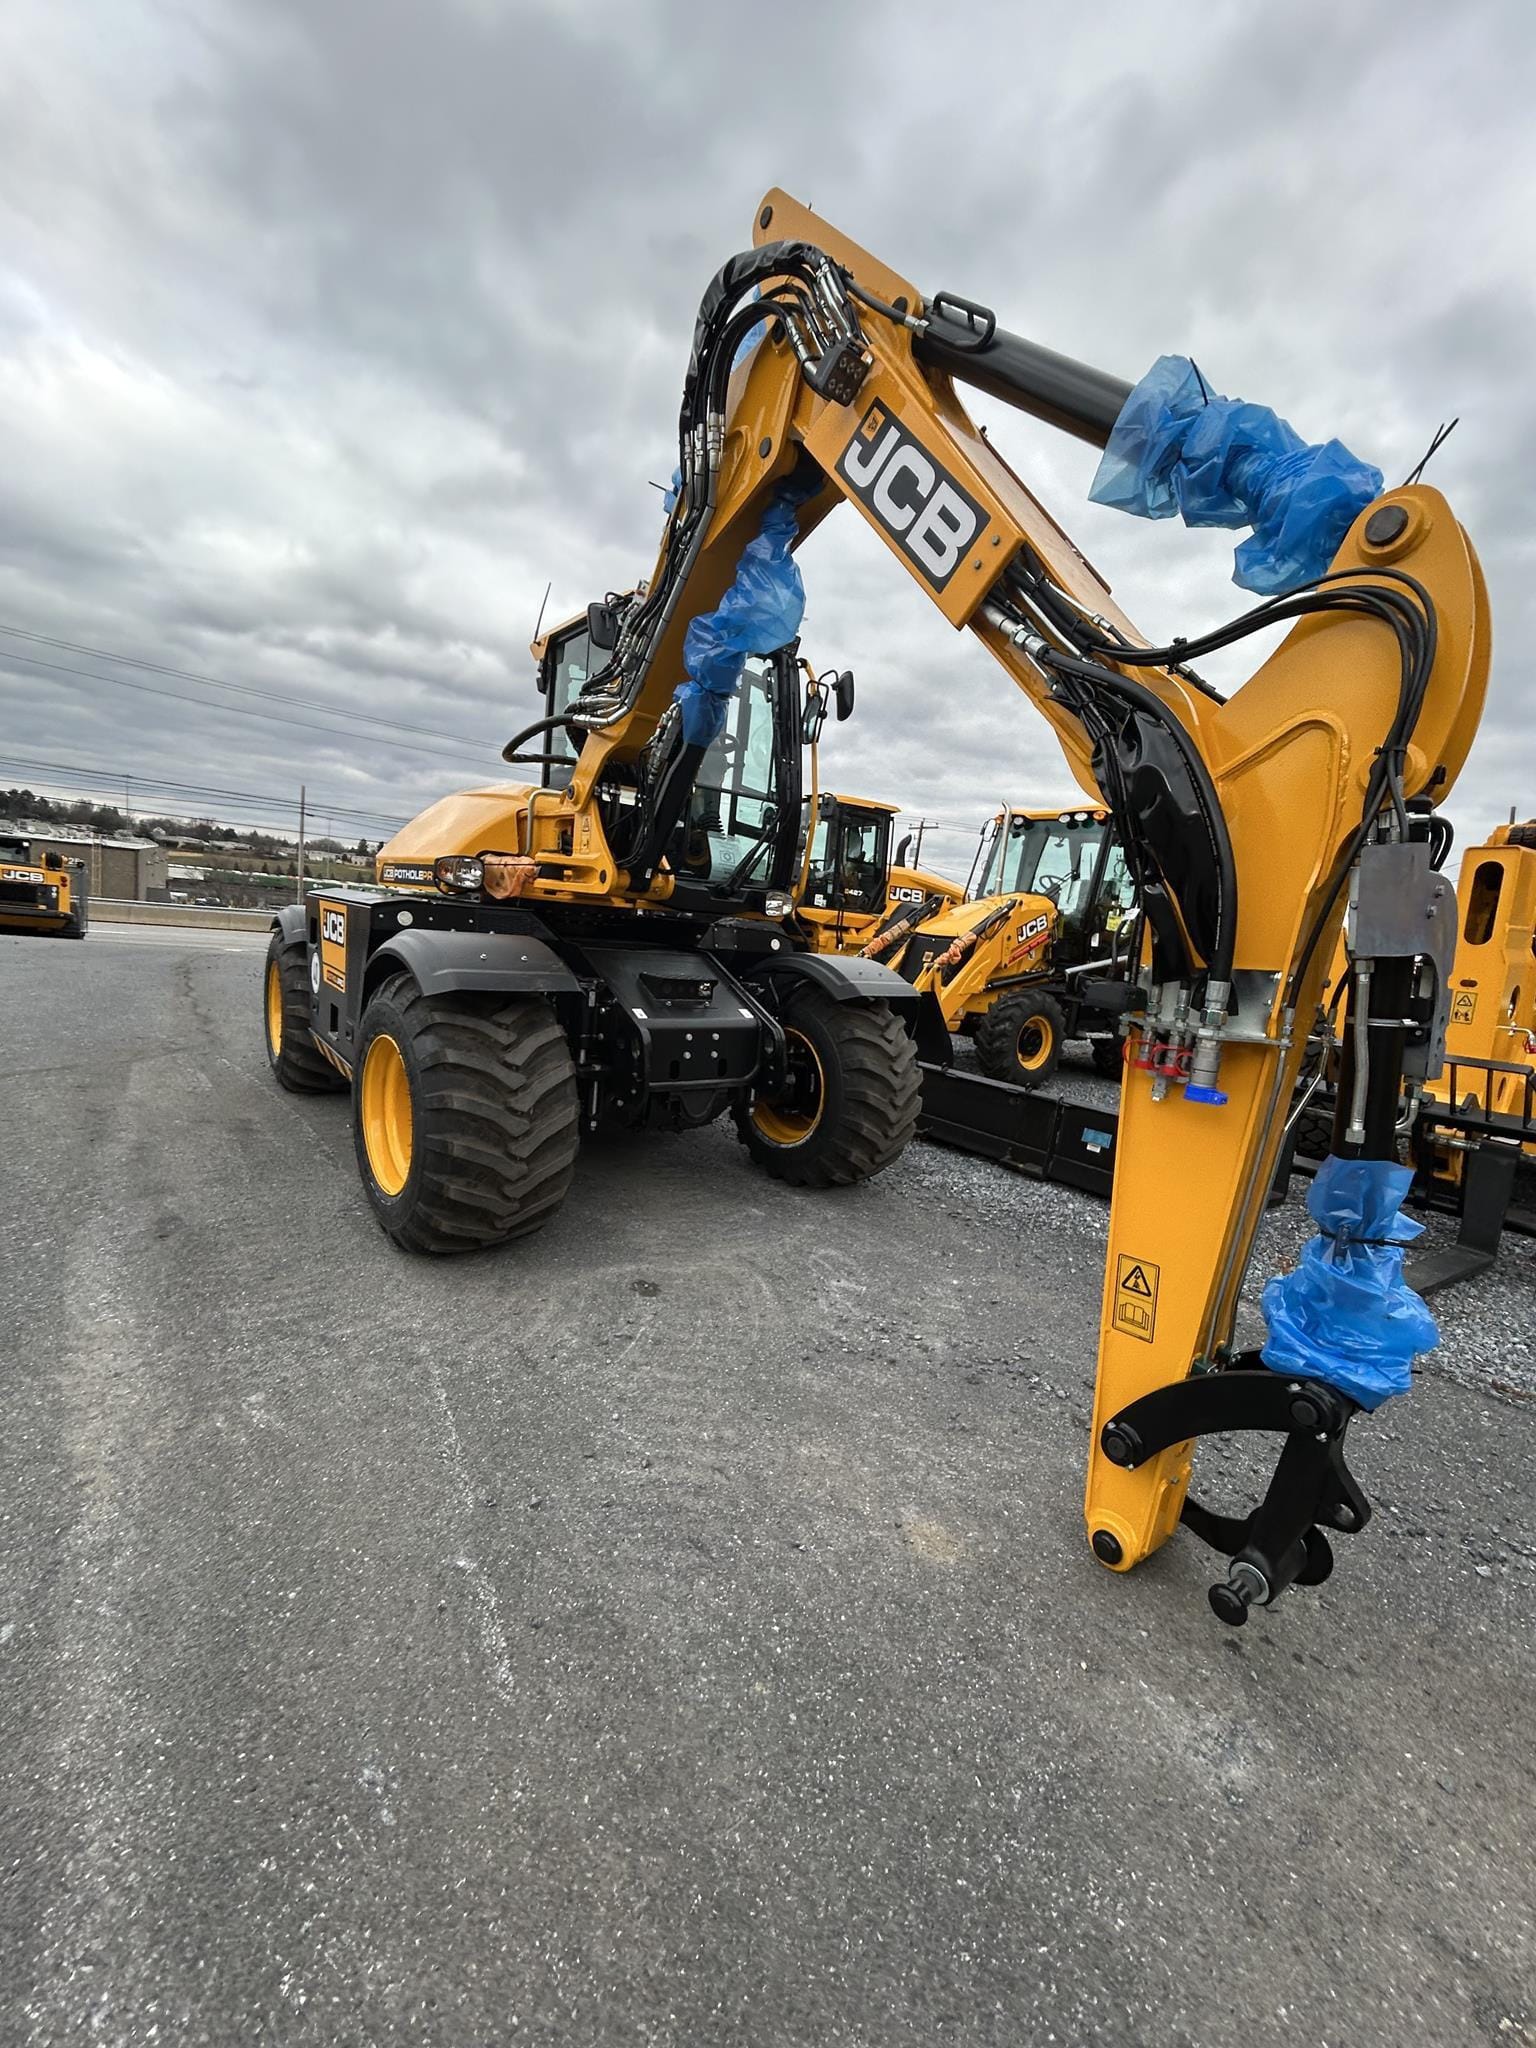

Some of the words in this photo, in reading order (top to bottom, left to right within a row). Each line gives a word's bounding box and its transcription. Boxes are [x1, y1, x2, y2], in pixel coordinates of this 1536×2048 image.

[844, 425, 977, 578] JCB
[3, 870, 44, 883] JCB
[394, 868, 433, 881] POTHOLEPR
[890, 887, 923, 903] JCB
[323, 911, 344, 944] JCB
[1018, 915, 1047, 942] JCB
